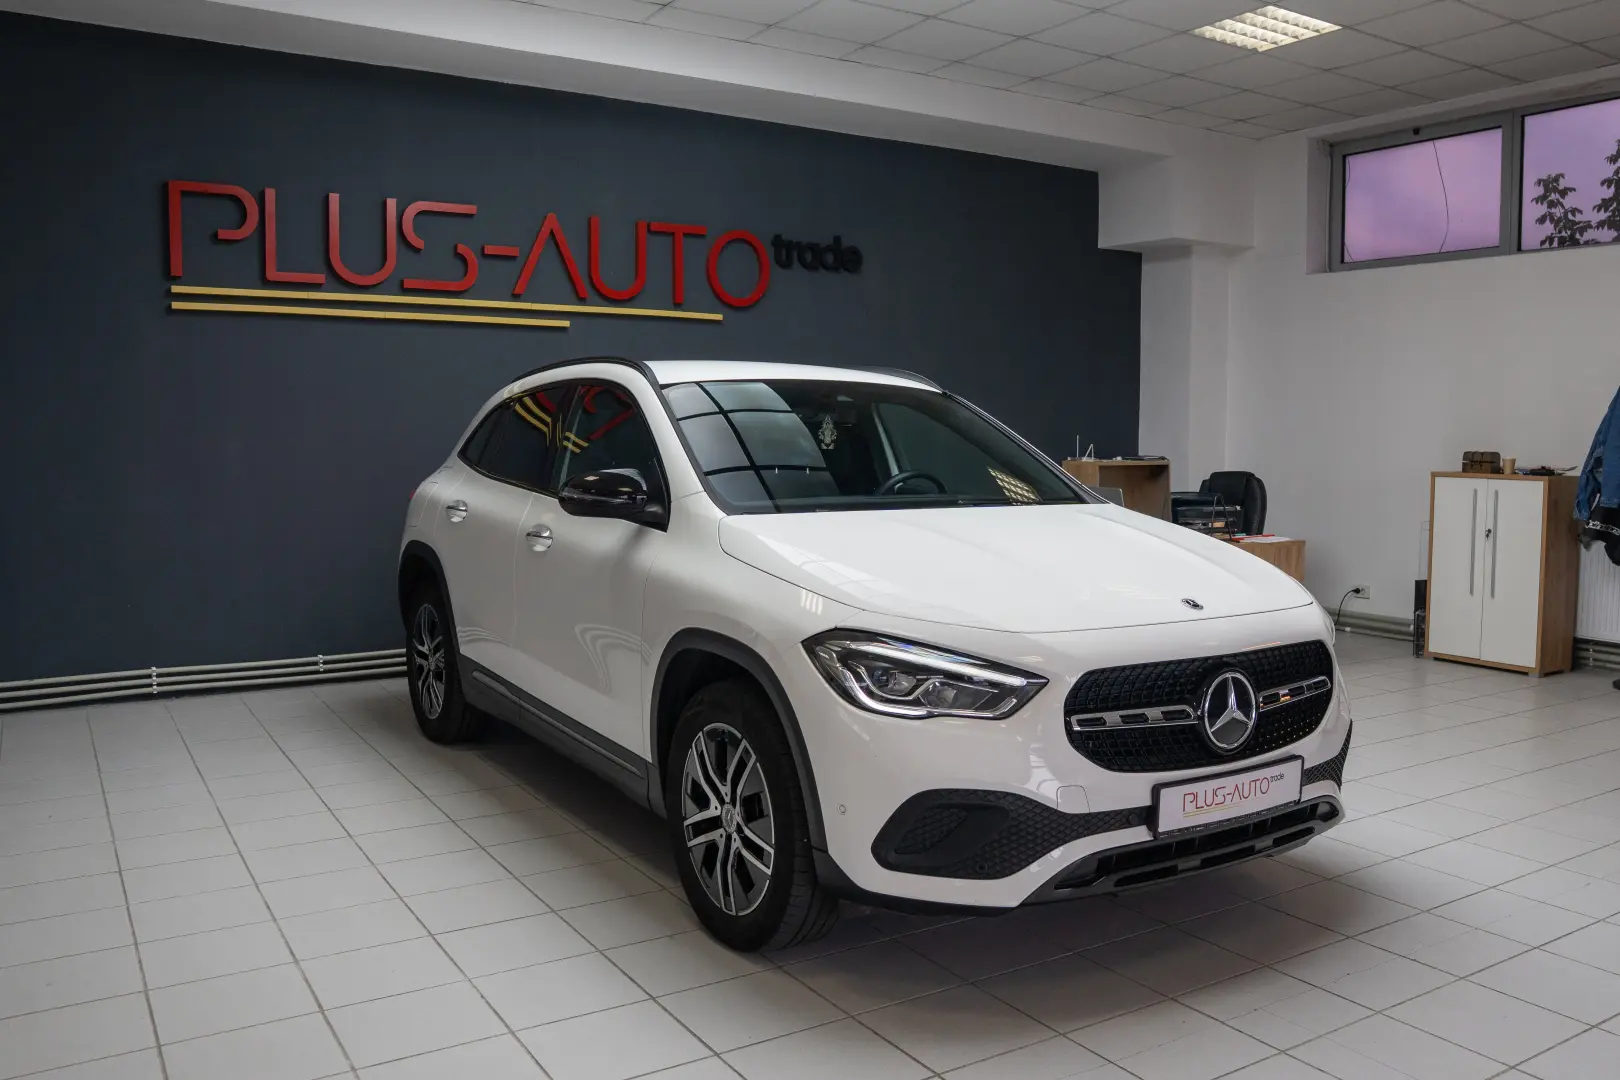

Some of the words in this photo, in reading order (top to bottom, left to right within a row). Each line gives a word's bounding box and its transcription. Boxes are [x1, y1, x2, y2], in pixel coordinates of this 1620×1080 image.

[167, 181, 771, 308] PLUS-AUTO
[771, 233, 863, 273] trade
[1182, 777, 1270, 812] PLUS-AUTO
